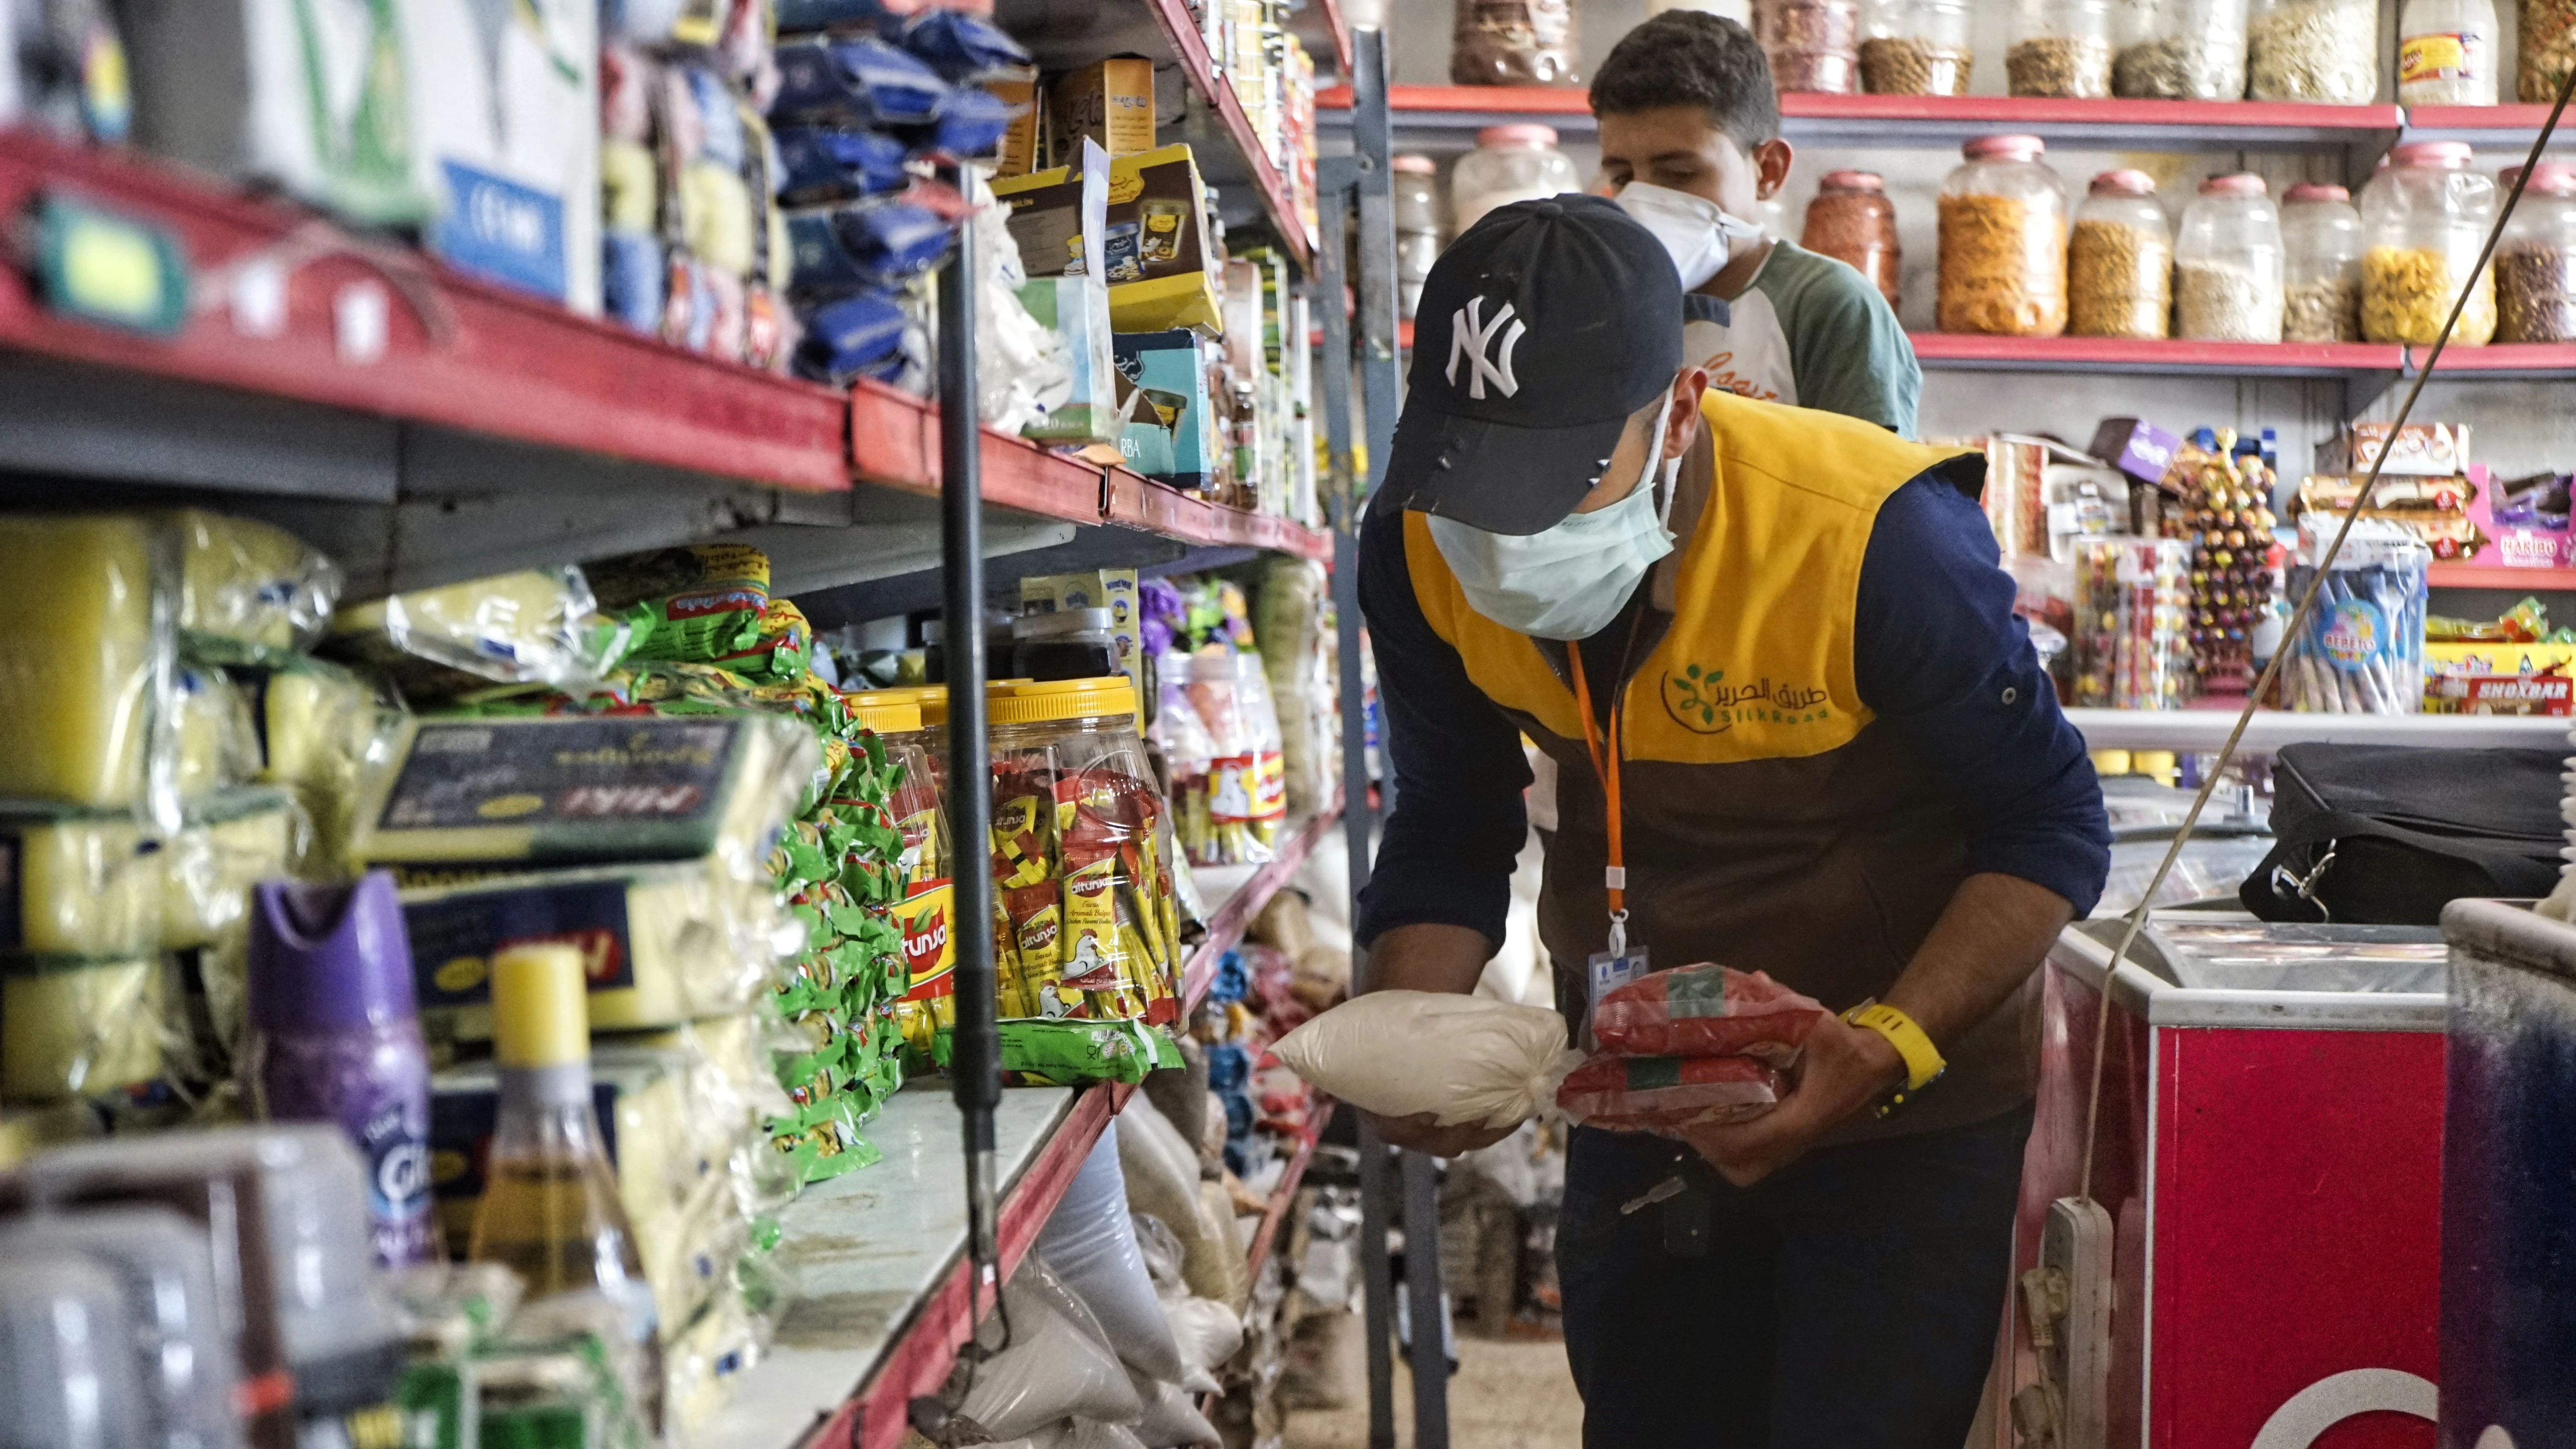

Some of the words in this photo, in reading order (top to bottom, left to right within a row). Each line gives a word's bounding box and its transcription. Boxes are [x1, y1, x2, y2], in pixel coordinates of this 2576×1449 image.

[1445, 294, 1526, 399] NY
[2500, 536, 2557, 556] HARIBO
[1715, 678, 1770, 706] الحرير
[1772, 684, 1826, 710] طريق
[1021, 925, 1058, 949] altunsa
